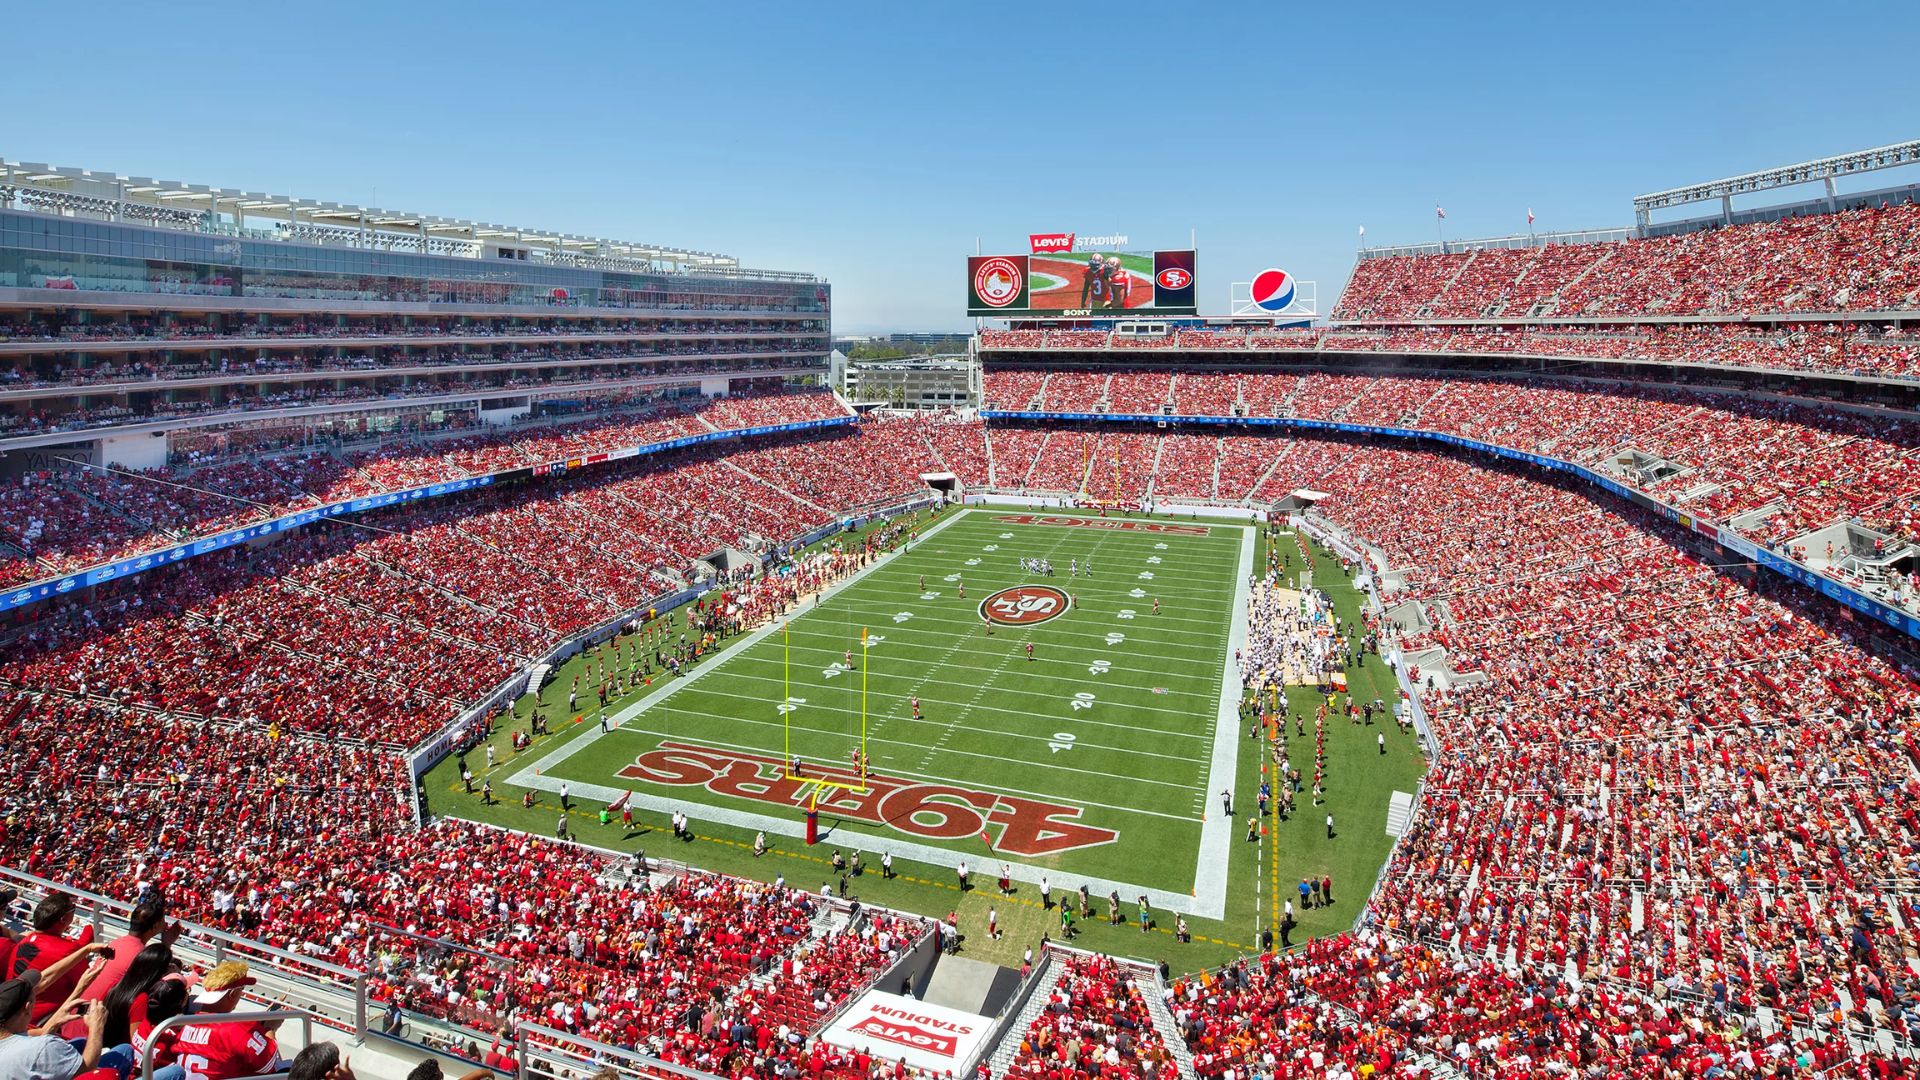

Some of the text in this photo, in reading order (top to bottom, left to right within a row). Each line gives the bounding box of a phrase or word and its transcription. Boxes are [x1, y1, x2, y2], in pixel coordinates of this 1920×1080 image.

[1076, 236, 1128, 246] STADIUM
[1092, 280, 1102, 295] 3
[23, 452, 92, 469] YAHOO!
[989, 514, 1211, 536] 49ERS
[1088, 660, 1112, 674] 30
[776, 697, 806, 712] 10
[1070, 692, 1095, 709] 20
[1048, 732, 1076, 751] 10
[613, 740, 1120, 857] 49ERS
[664, 1019, 674, 1029] 52
[870, 1004, 973, 1035] STADIUM
[247, 1031, 268, 1055] 16
[177, 1053, 209, 1080] 16
